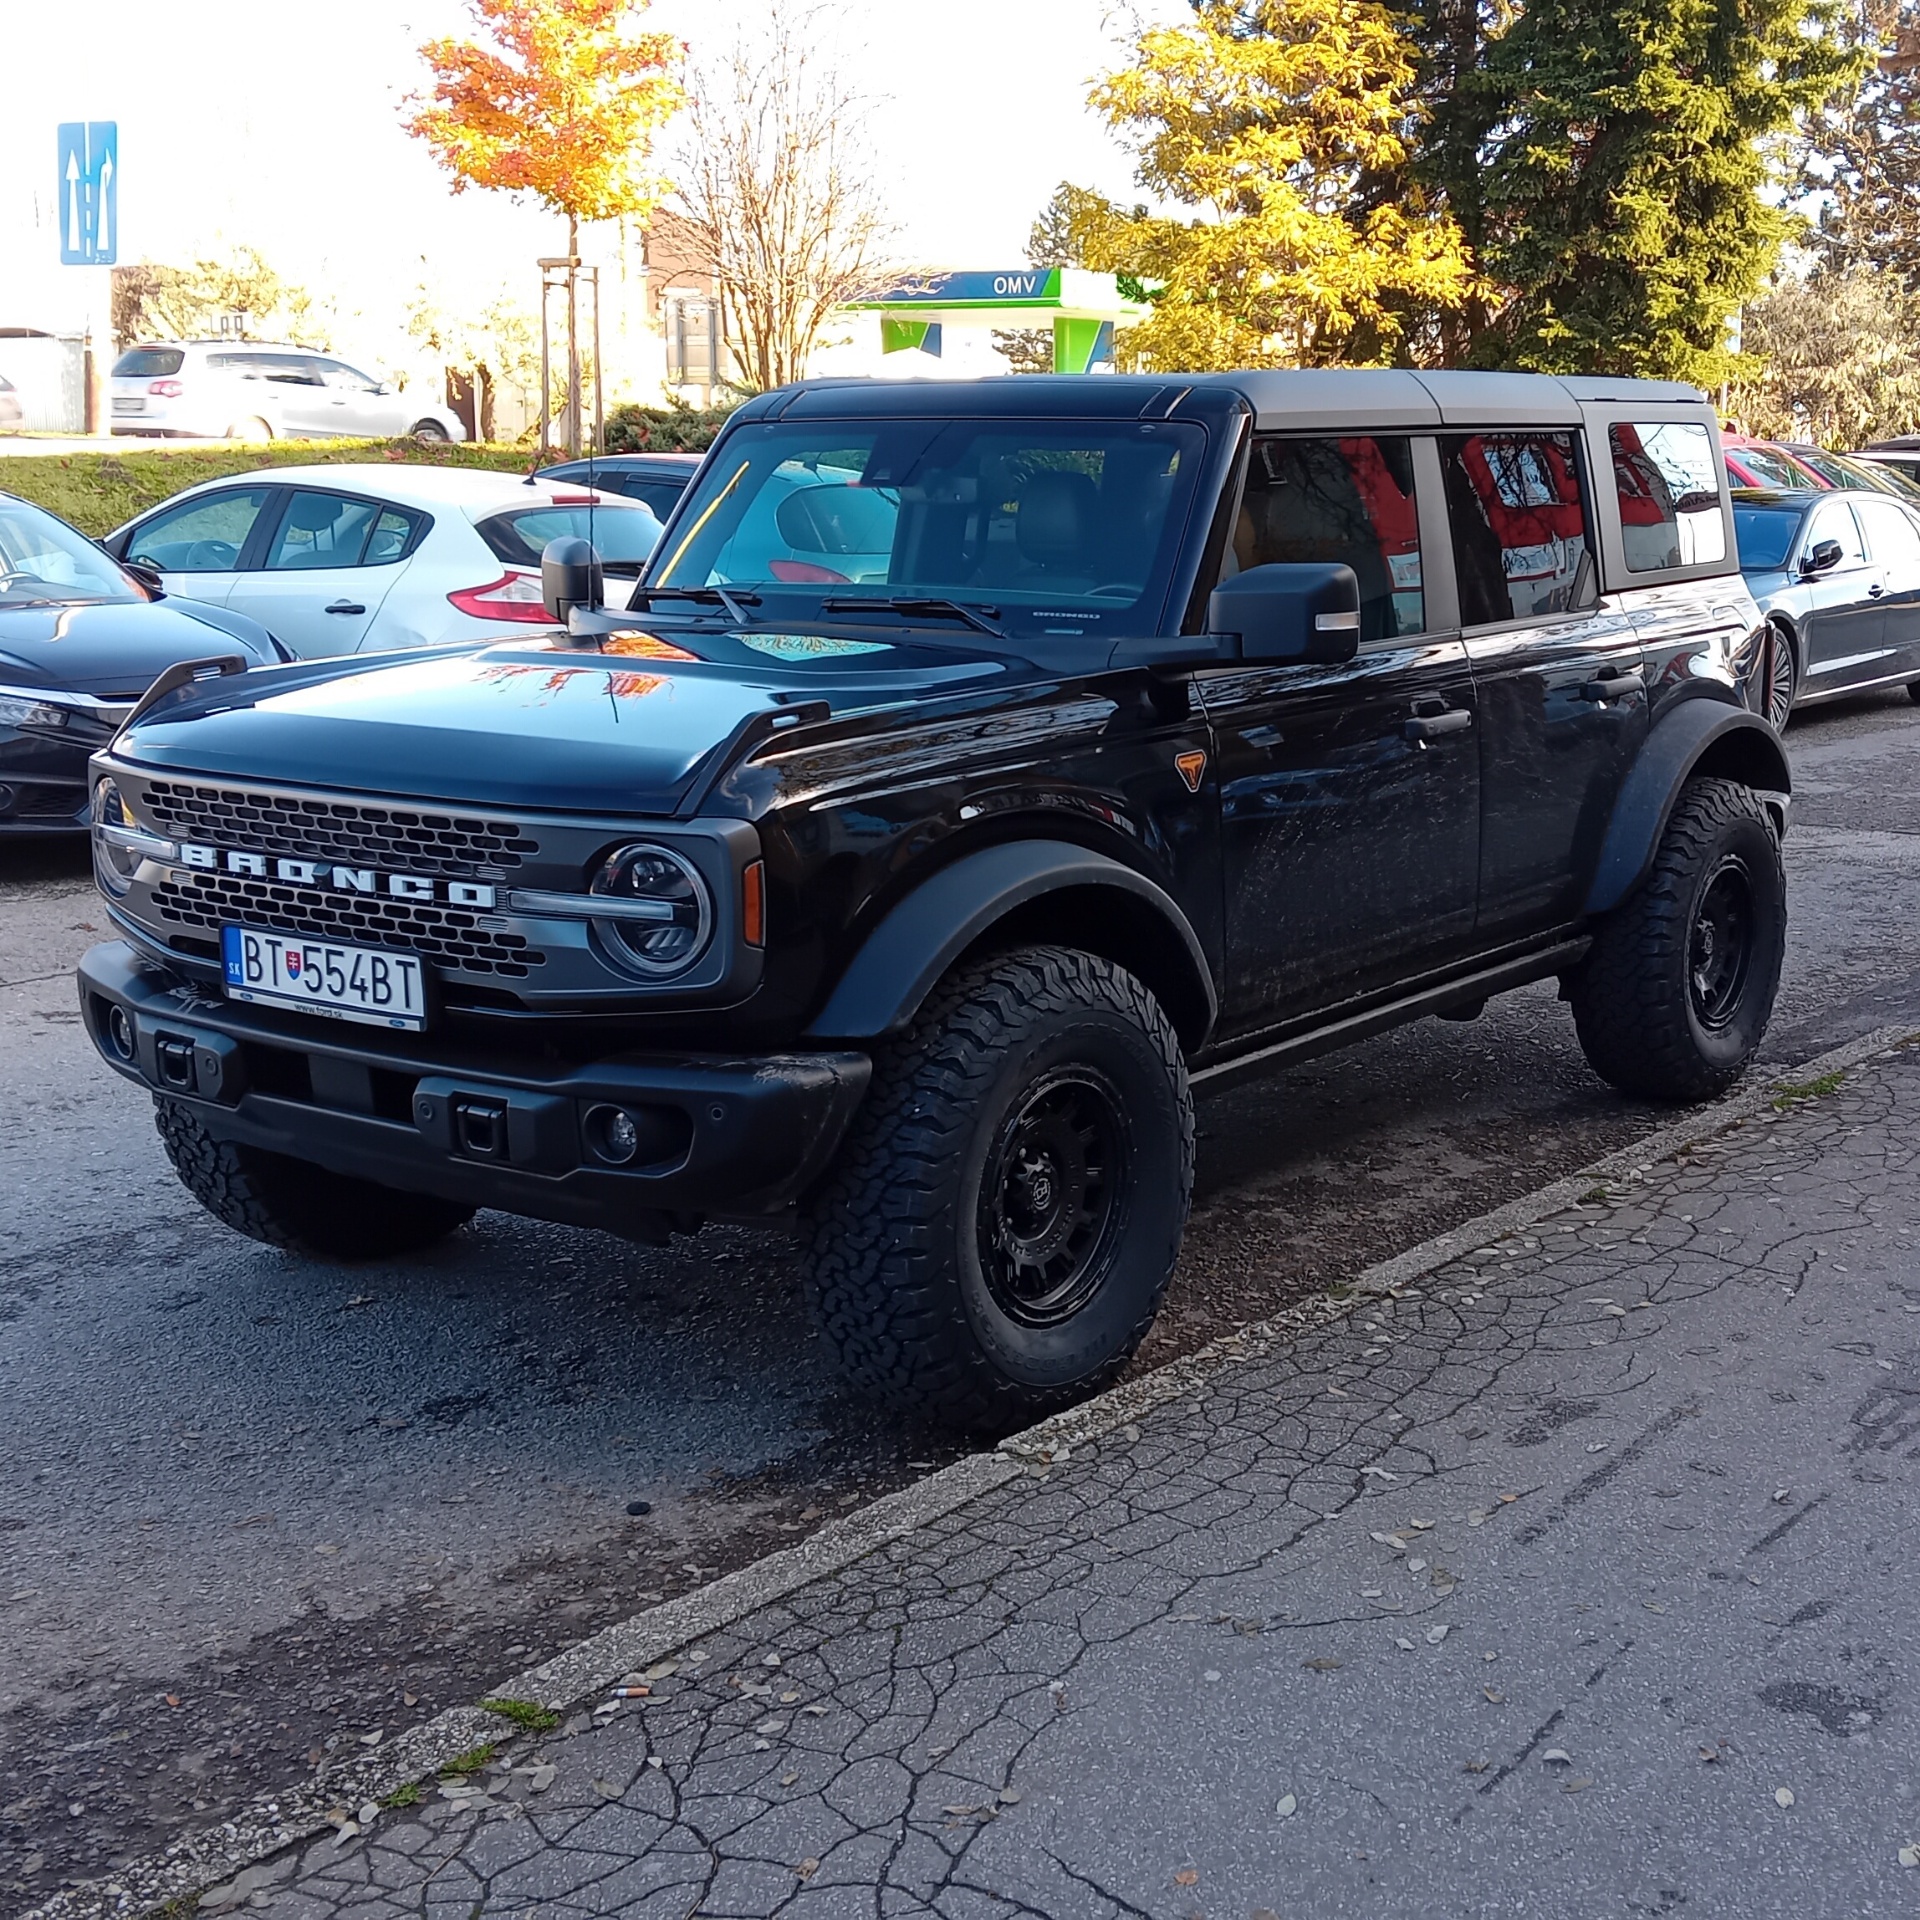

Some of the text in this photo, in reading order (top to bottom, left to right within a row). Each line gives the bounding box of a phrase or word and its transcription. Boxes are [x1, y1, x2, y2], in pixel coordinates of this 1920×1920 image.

[993, 275, 1036, 295] OMV
[181, 843, 496, 908] BRONCO
[229, 962, 240, 976] SK
[244, 935, 416, 1009] BT 554BT
